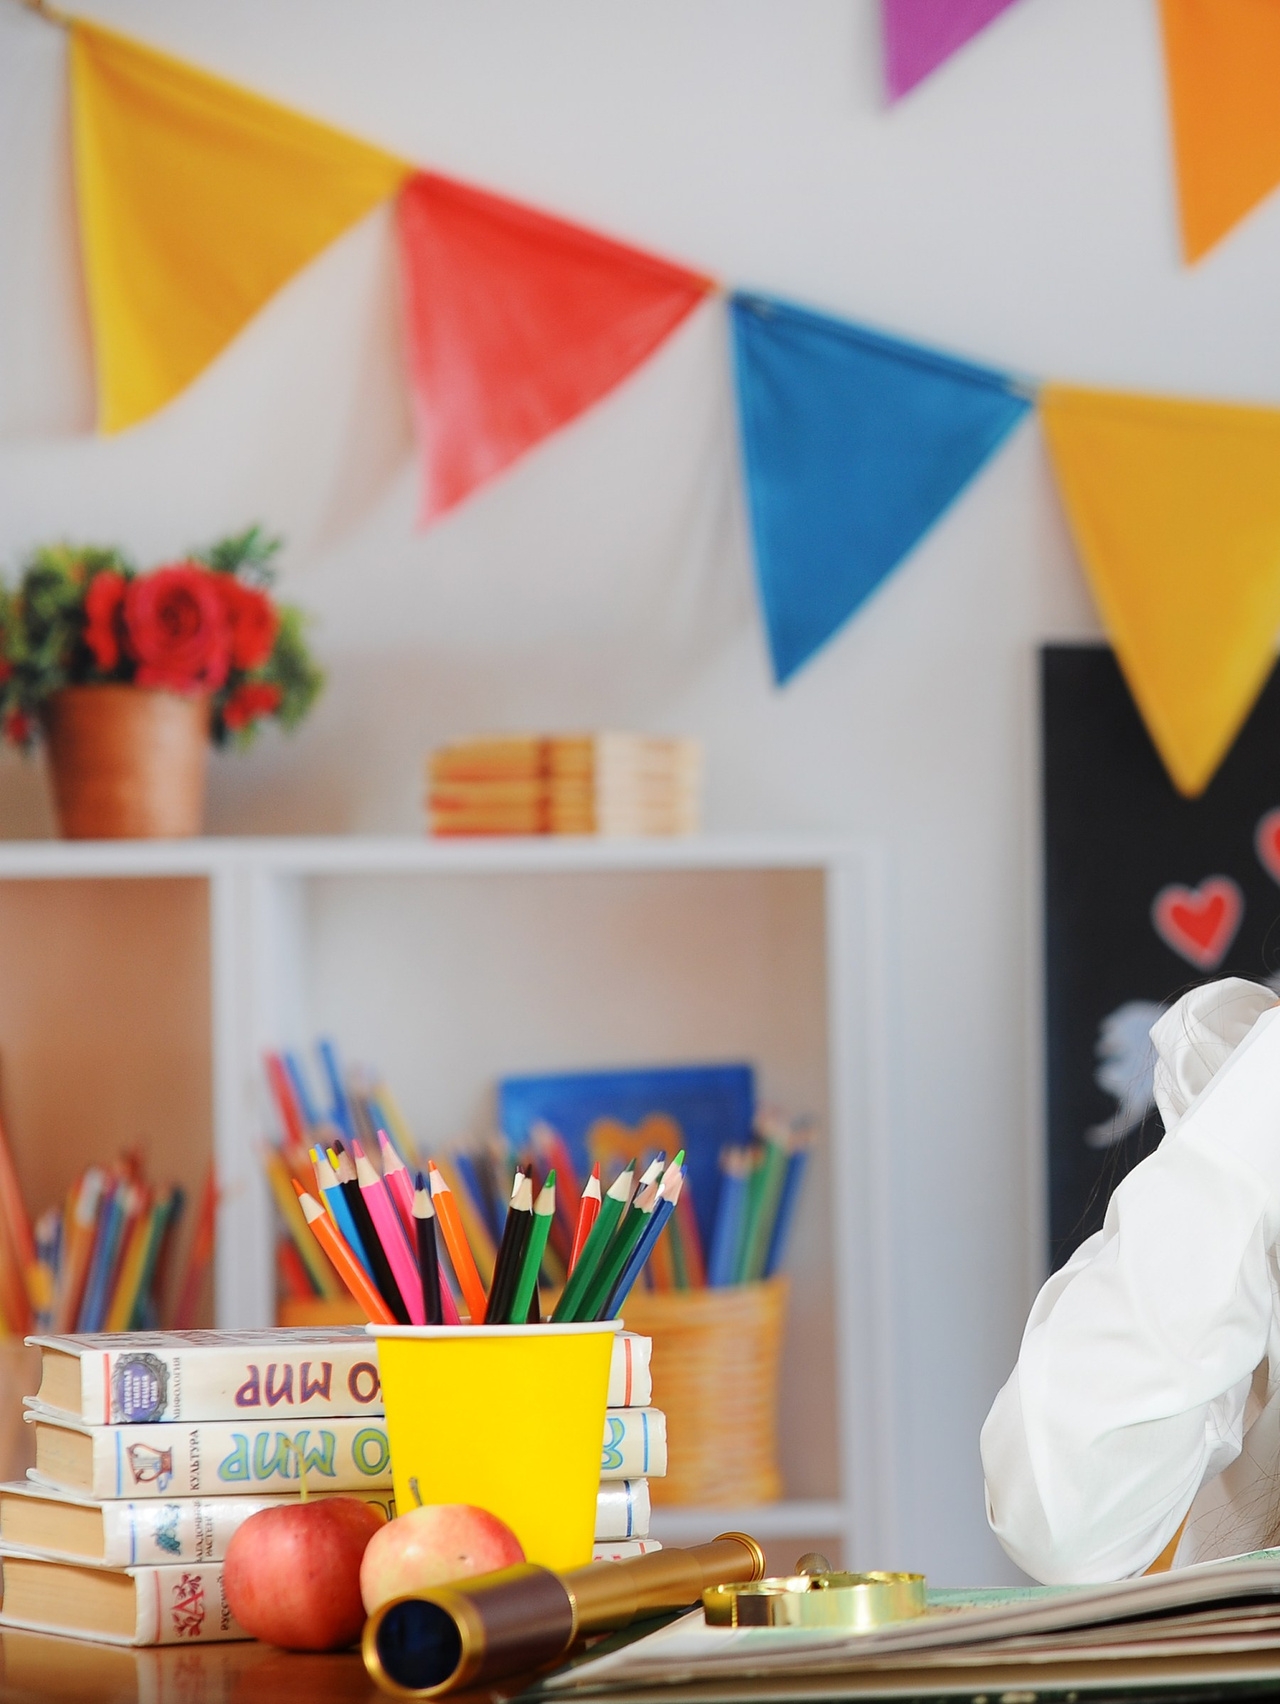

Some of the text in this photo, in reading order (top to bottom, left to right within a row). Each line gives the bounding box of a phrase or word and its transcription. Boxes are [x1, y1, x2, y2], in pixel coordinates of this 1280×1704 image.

[133, 1376, 141, 1408] ЕГИПЕТ
[142, 1374, 150, 1409] ГРЕЦИЯ
[150, 1381, 158, 1402] РИМ
[173, 1357, 181, 1420] МИФОЛОГИЯ
[235, 1361, 333, 1408] МИР
[188, 1428, 200, 1491] КУЛЬТУРА
[217, 1430, 337, 1482] МИР
